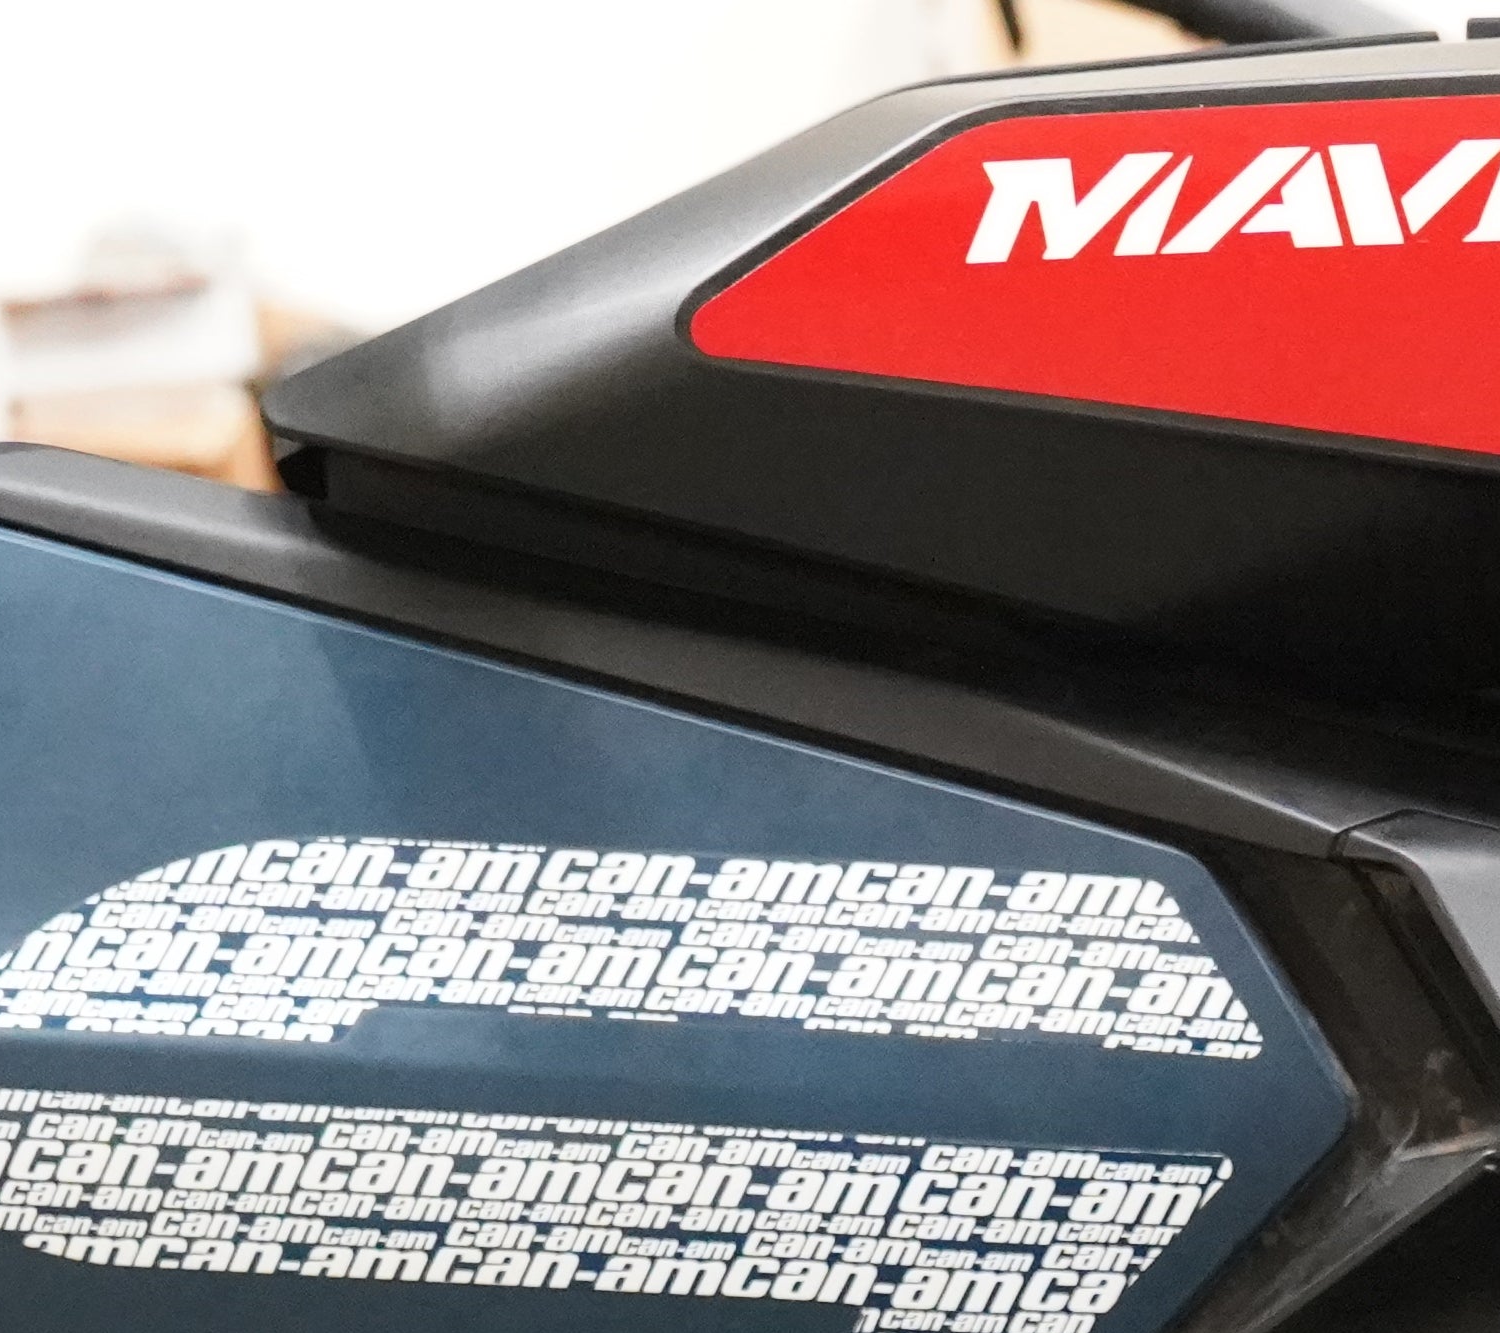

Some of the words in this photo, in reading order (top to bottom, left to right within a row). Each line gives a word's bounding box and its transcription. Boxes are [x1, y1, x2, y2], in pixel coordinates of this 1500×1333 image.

[229, 882, 397, 911] can-am
[524, 890, 695, 922] can-am
[824, 901, 996, 935] can-am
[240, 840, 542, 893] can-am
[536, 848, 842, 904] can-am
[836, 859, 1142, 918] can-am
[65, 927, 364, 977] can-am
[356, 934, 662, 989] can-am
[655, 945, 963, 1003] can-am
[89, 902, 264, 933] can-am
[380, 909, 560, 942] can-am
[679, 919, 860, 954] can-am
[979, 932, 1160, 970] can-am
[344, 975, 515, 1006] can-am
[643, 986, 815, 1019] can-am
[944, 1001, 1116, 1036] can-am
[27, 1112, 201, 1146] can-am
[319, 1123, 498, 1156] can-am
[617, 1134, 799, 1168] can-am
[919, 1146, 1101, 1180] can-am
[0, 1179, 163, 1212] can-am
[289, 1190, 457, 1222] can-am
[585, 1201, 756, 1233] can-am
[885, 1212, 1056, 1244] can-am
[9, 1138, 303, 1193] can-am
[299, 1148, 601, 1204] can-am
[596, 1159, 902, 1215] can-am
[896, 1171, 1204, 1226] can-am
[151, 1209, 325, 1244] can-am
[444, 1220, 622, 1255] can-am
[741, 1231, 921, 1266] can-am
[720, 1258, 1024, 1314] can-am
